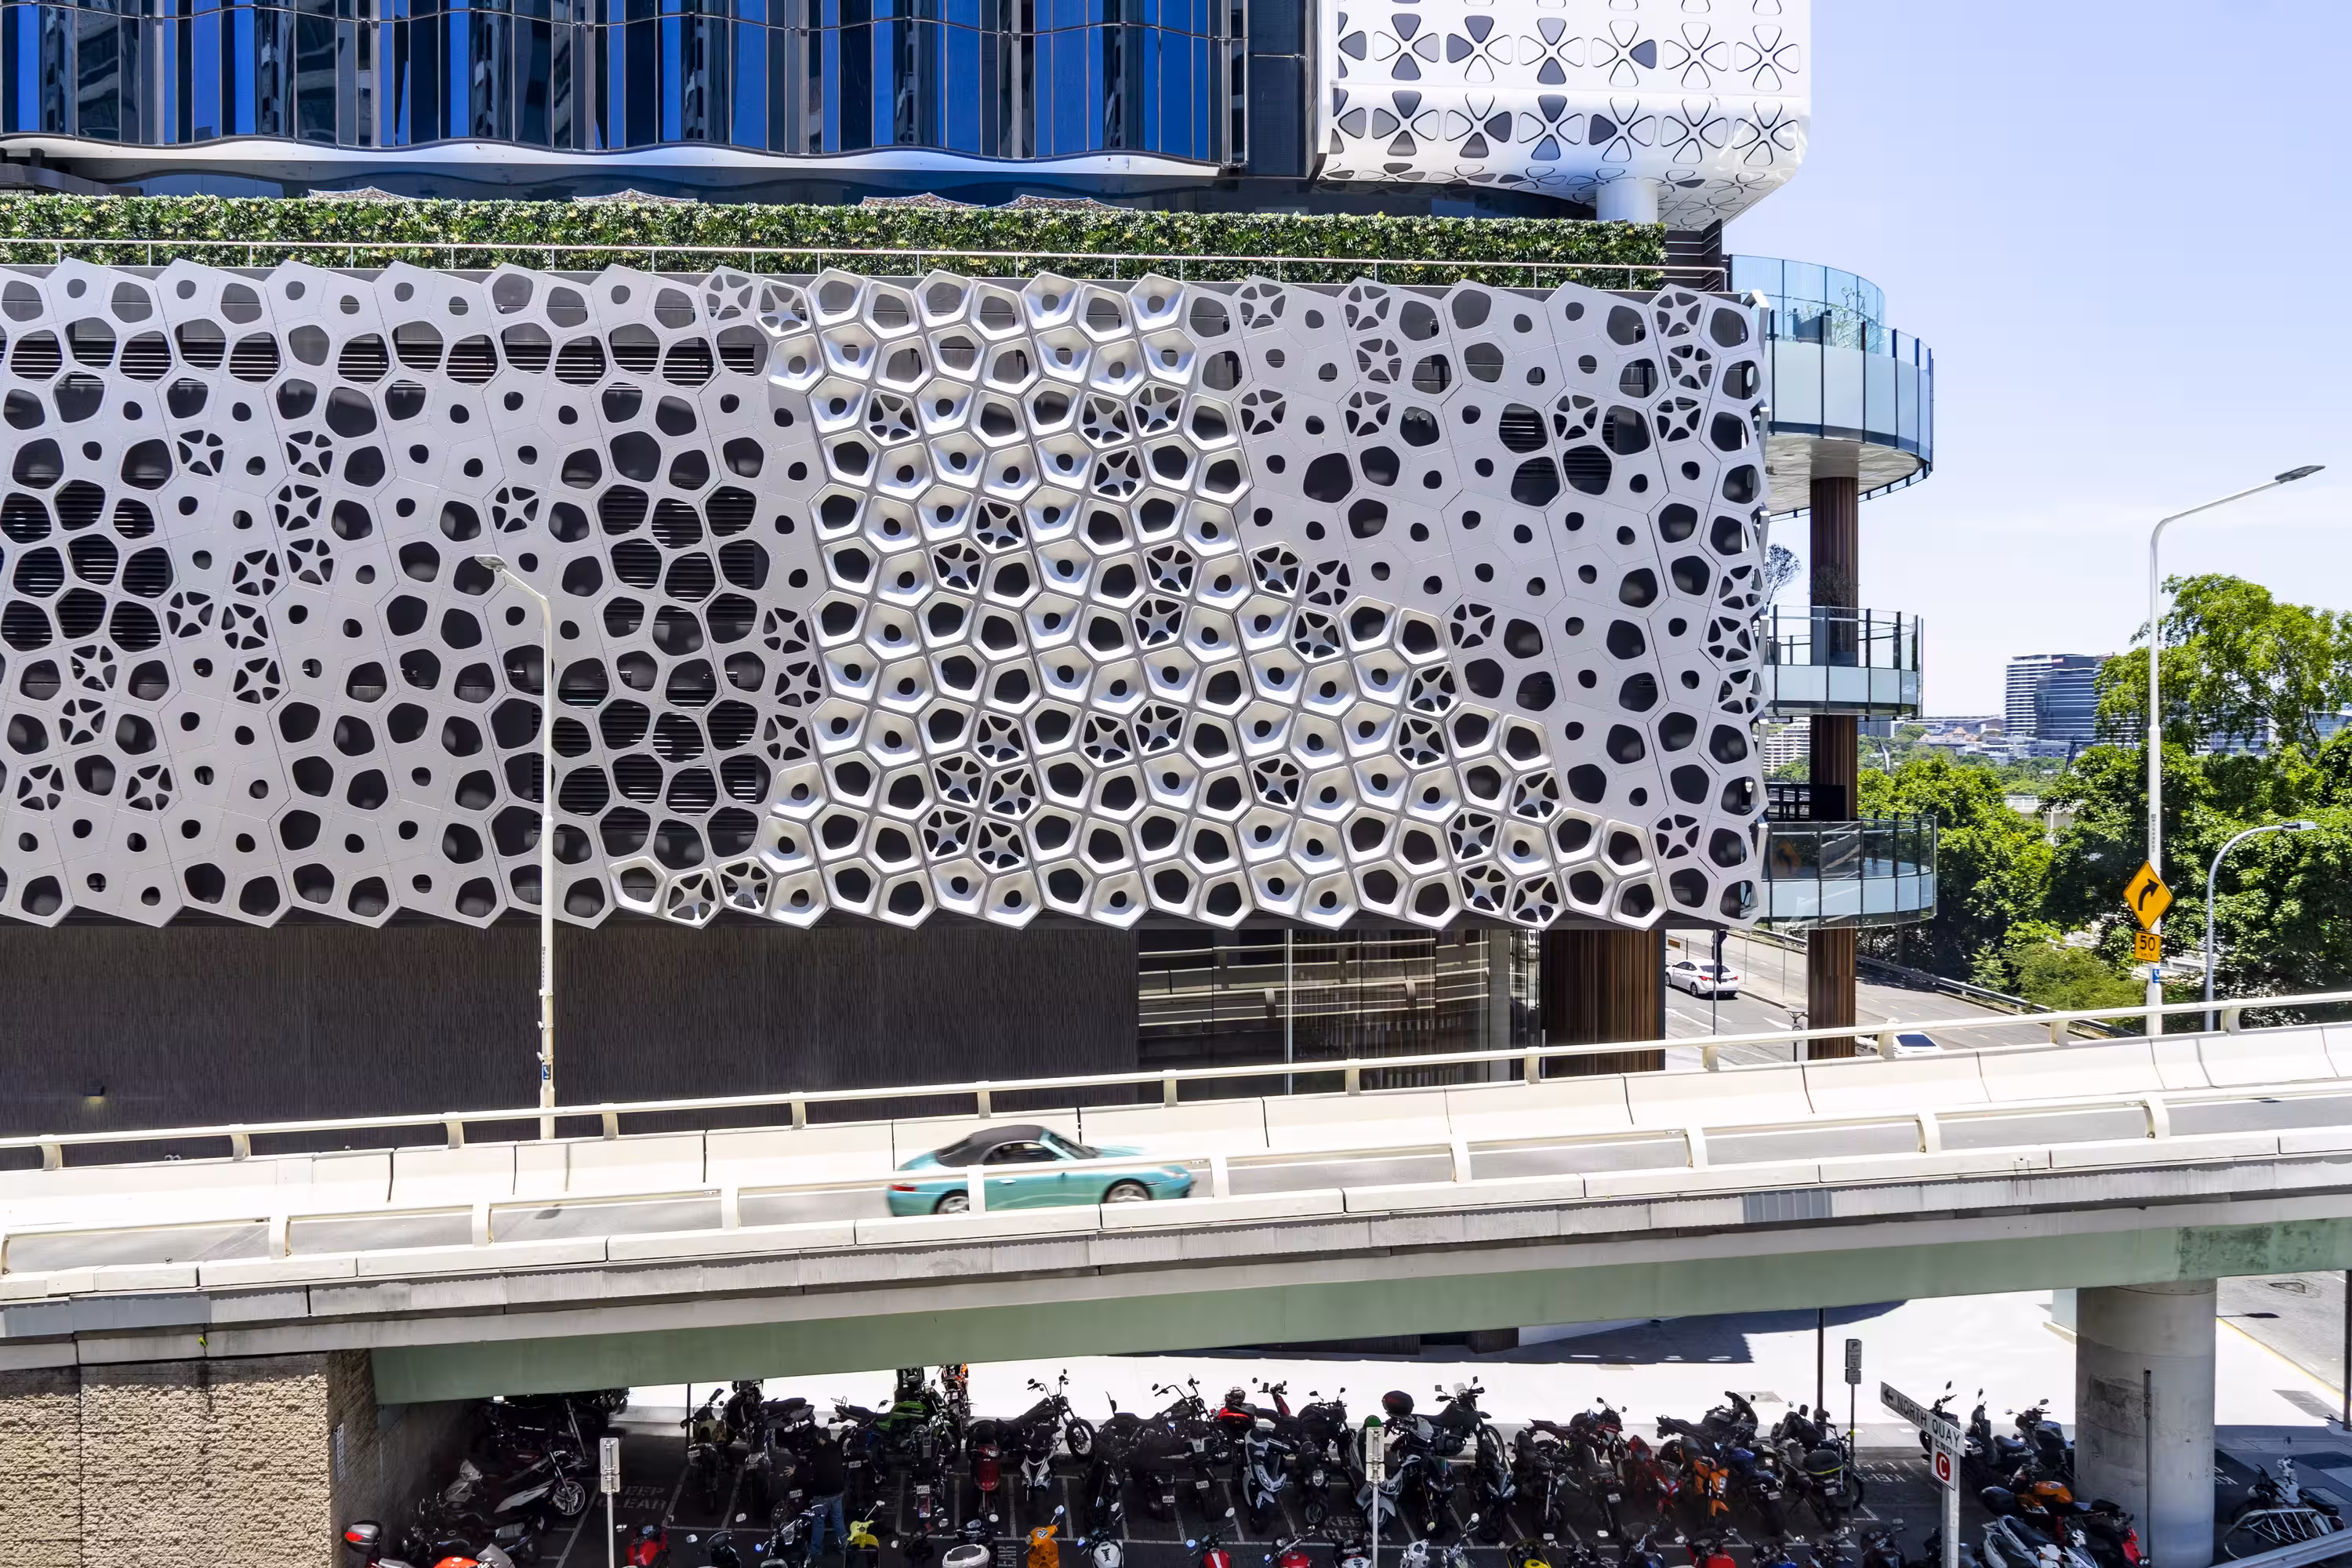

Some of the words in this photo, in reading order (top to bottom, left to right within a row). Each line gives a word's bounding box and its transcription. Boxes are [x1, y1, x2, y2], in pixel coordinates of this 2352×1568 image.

[2140, 935, 2155, 951] 50
[1897, 1396, 1927, 1428] NORTH
[1933, 1419, 1960, 1448] QUAY
